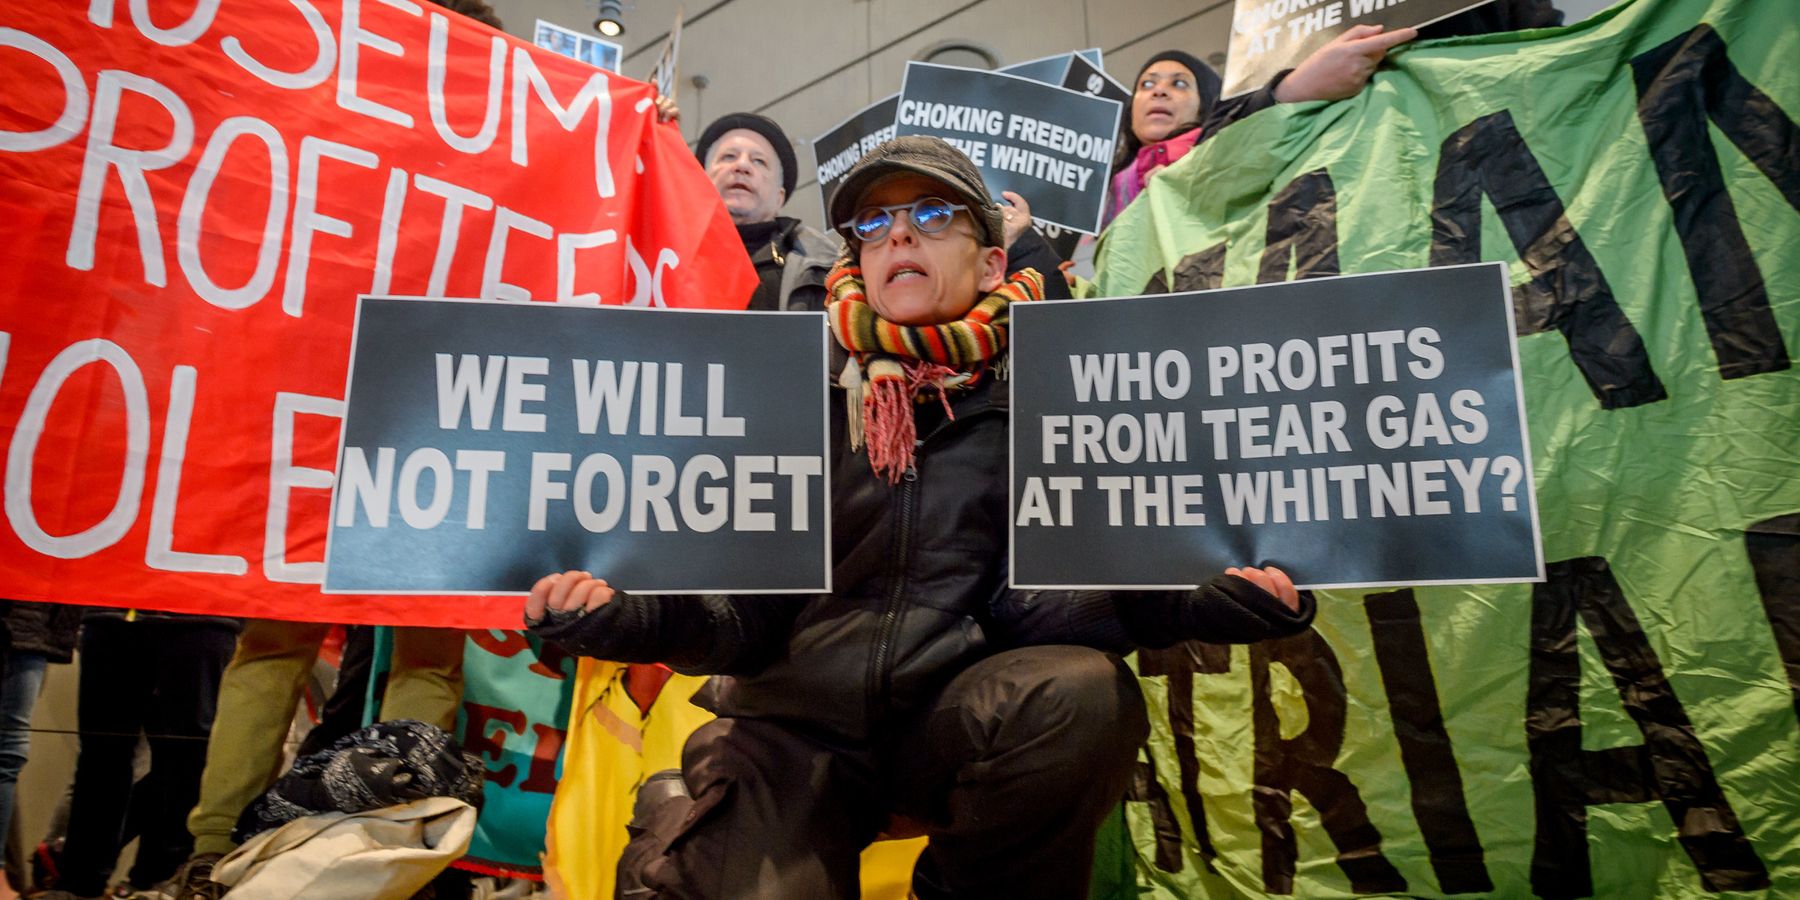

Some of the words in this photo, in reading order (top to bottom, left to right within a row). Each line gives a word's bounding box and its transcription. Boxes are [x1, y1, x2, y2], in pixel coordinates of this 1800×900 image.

[1247, 26, 1281, 59] AT
[1288, 3, 1343, 42] THE
[818, 142, 860, 185] CHOKING
[899, 99, 1004, 136] CHOKING
[1006, 113, 1112, 164] FREEDOM
[991, 143, 1094, 192] WHITNEY
[435, 353, 550, 432] WE
[572, 358, 746, 437] WILL
[1069, 349, 1192, 402] WHO
[1207, 326, 1446, 397] PROFITS
[1041, 411, 1188, 464] FROM
[1202, 400, 1353, 460] TEAR
[1366, 389, 1490, 449] GAS
[335, 446, 506, 530] NOT
[527, 451, 823, 533] FORGET
[1016, 476, 1083, 527] AT
[1097, 474, 1207, 527] THE
[1218, 455, 1524, 526] WHITNEY?
